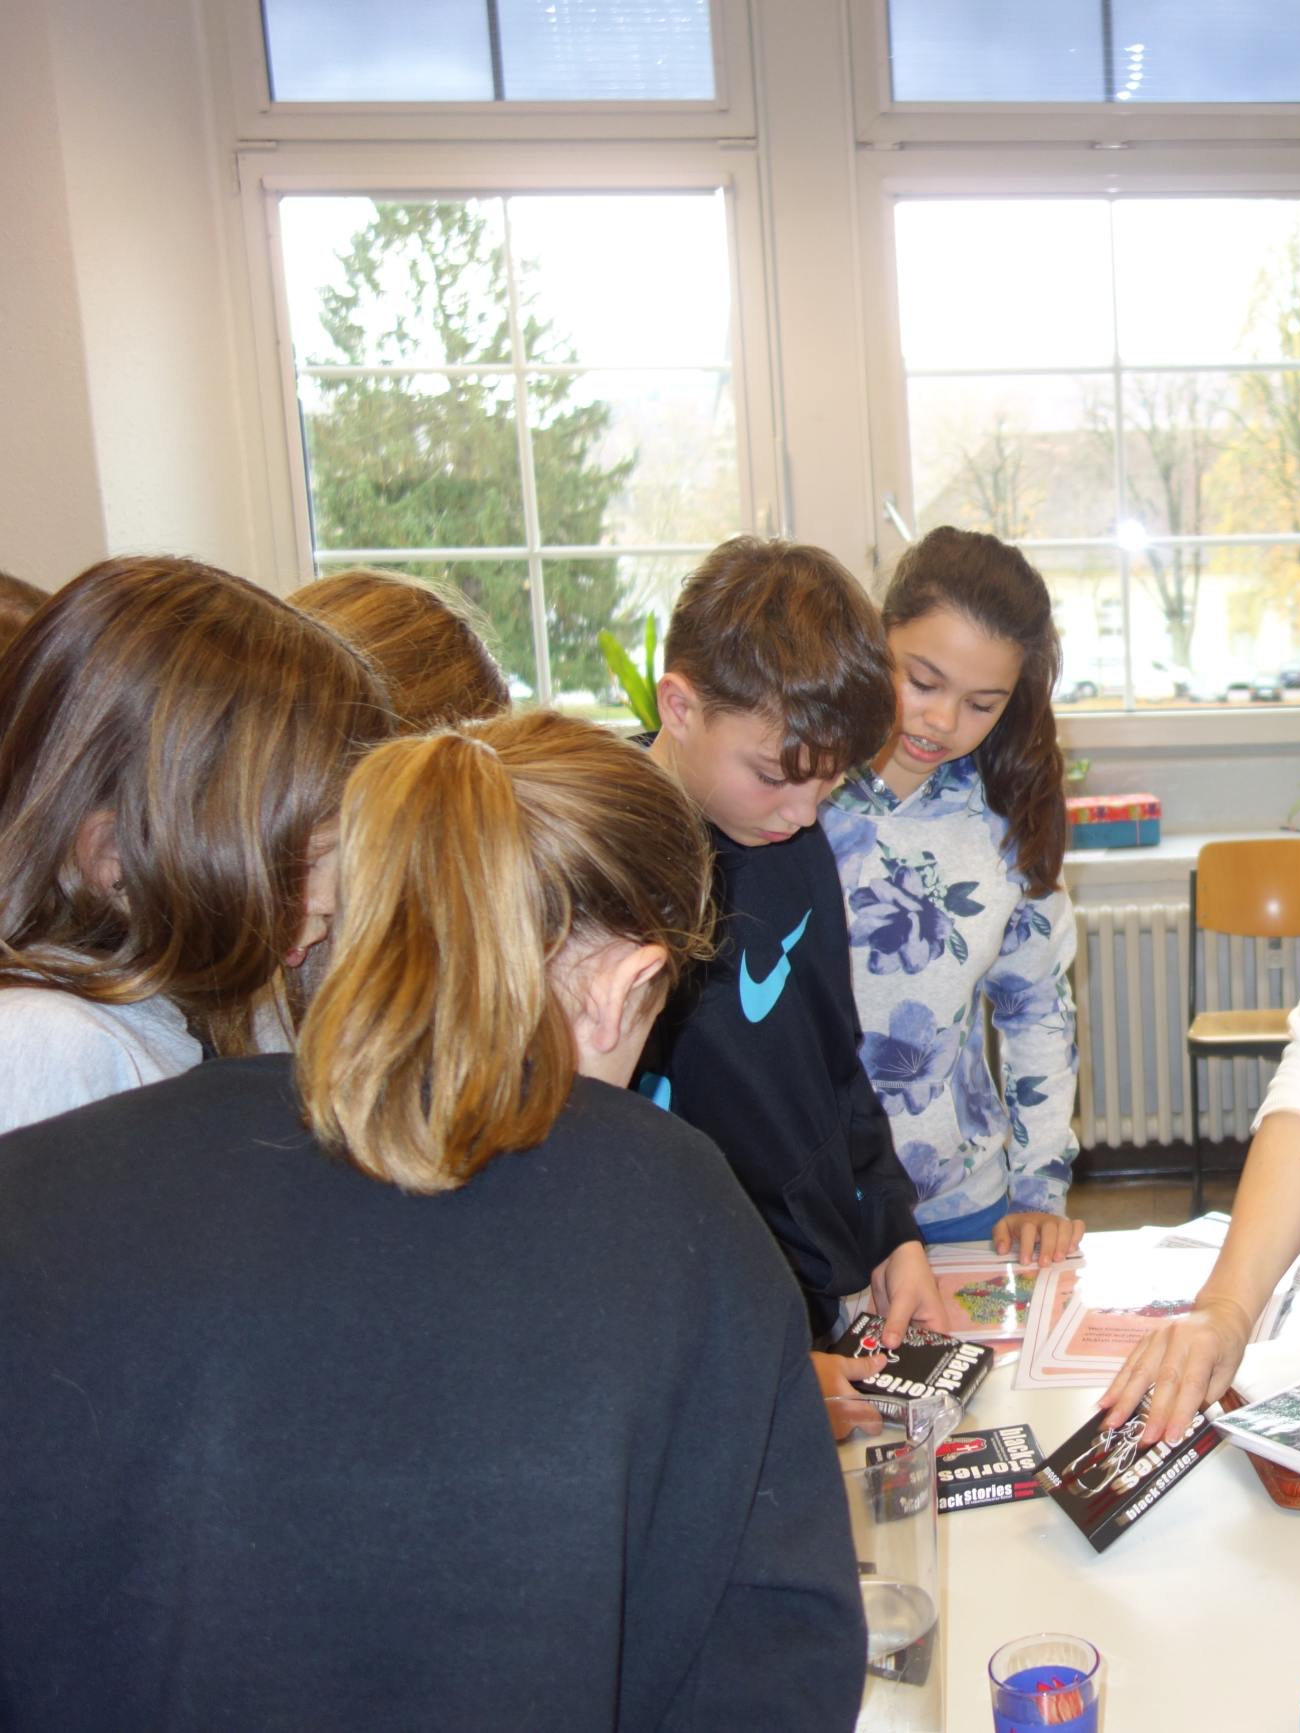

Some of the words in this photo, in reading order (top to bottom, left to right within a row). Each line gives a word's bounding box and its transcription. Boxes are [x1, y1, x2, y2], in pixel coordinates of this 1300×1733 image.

[935, 1344, 985, 1391] black
[999, 1427, 1035, 1462] black
[938, 1457, 1036, 1481] stories
[1126, 1485, 1161, 1521] black
[1156, 1448, 1199, 1490] stories
[964, 1483, 1012, 1502] stories
